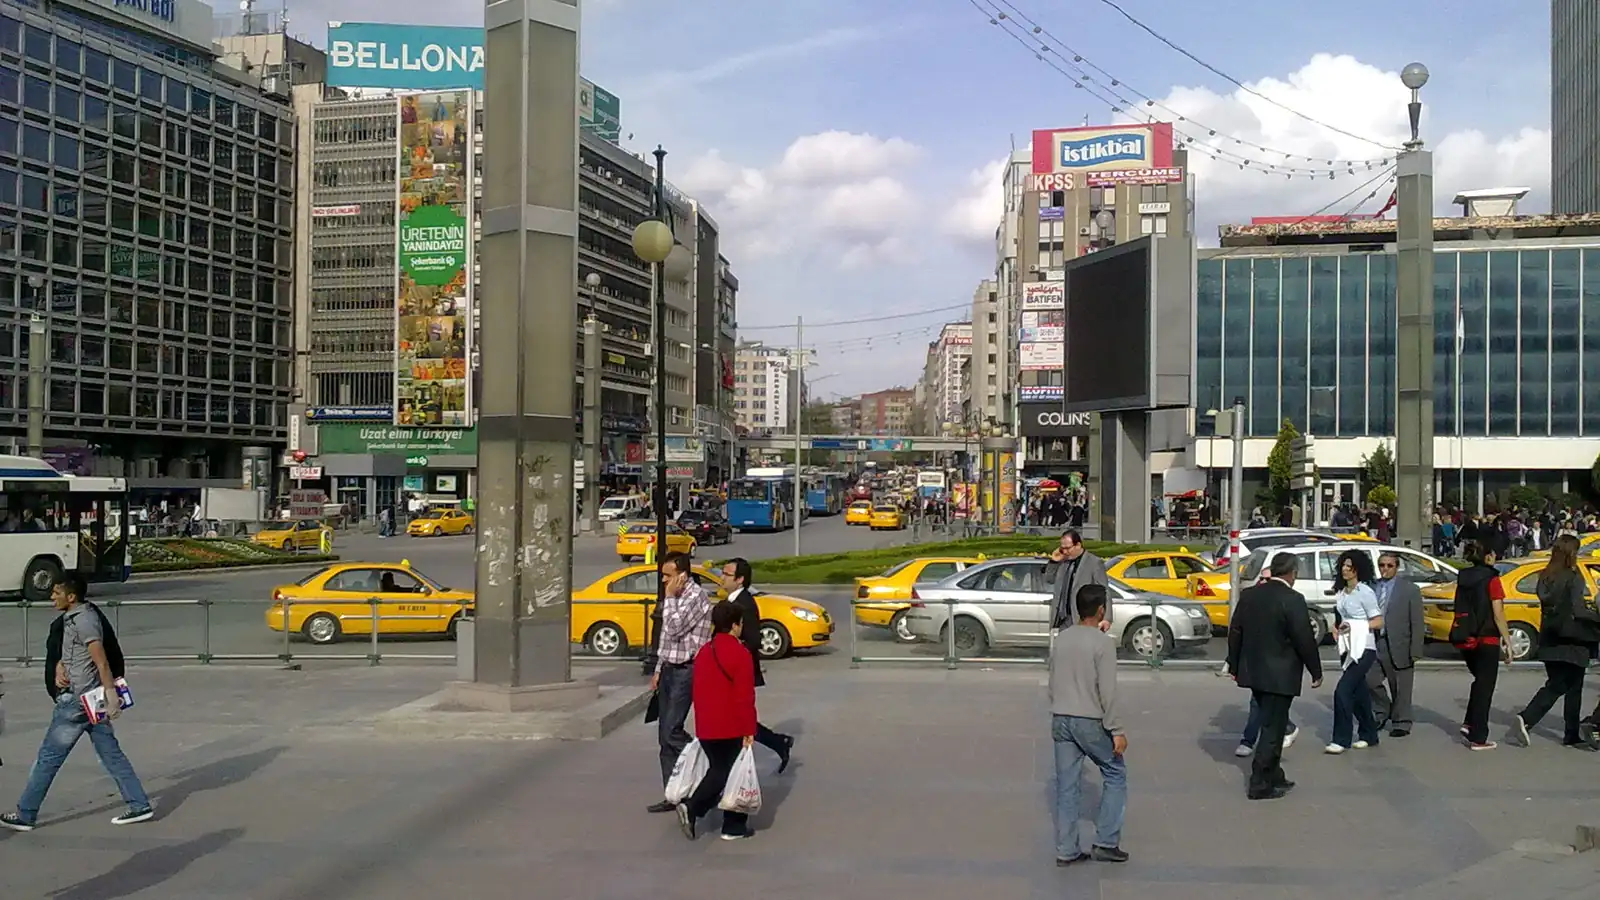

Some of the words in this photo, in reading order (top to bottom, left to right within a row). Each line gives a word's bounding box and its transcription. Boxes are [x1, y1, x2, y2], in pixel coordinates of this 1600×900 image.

[330, 41, 485, 72] BELLONA
[1063, 138, 1142, 162] istikbal
[1088, 167, 1180, 179] TERCÜME
[1034, 173, 1074, 192] KPSS
[401, 223, 464, 241] ÜRETENİN
[402, 239, 464, 251] YANINDAYIZ!
[1037, 411, 1091, 426] COLIN'S
[359, 428, 386, 439] Uzat
[388, 429, 413, 439] elini
[416, 429, 463, 442] Türkiye!
